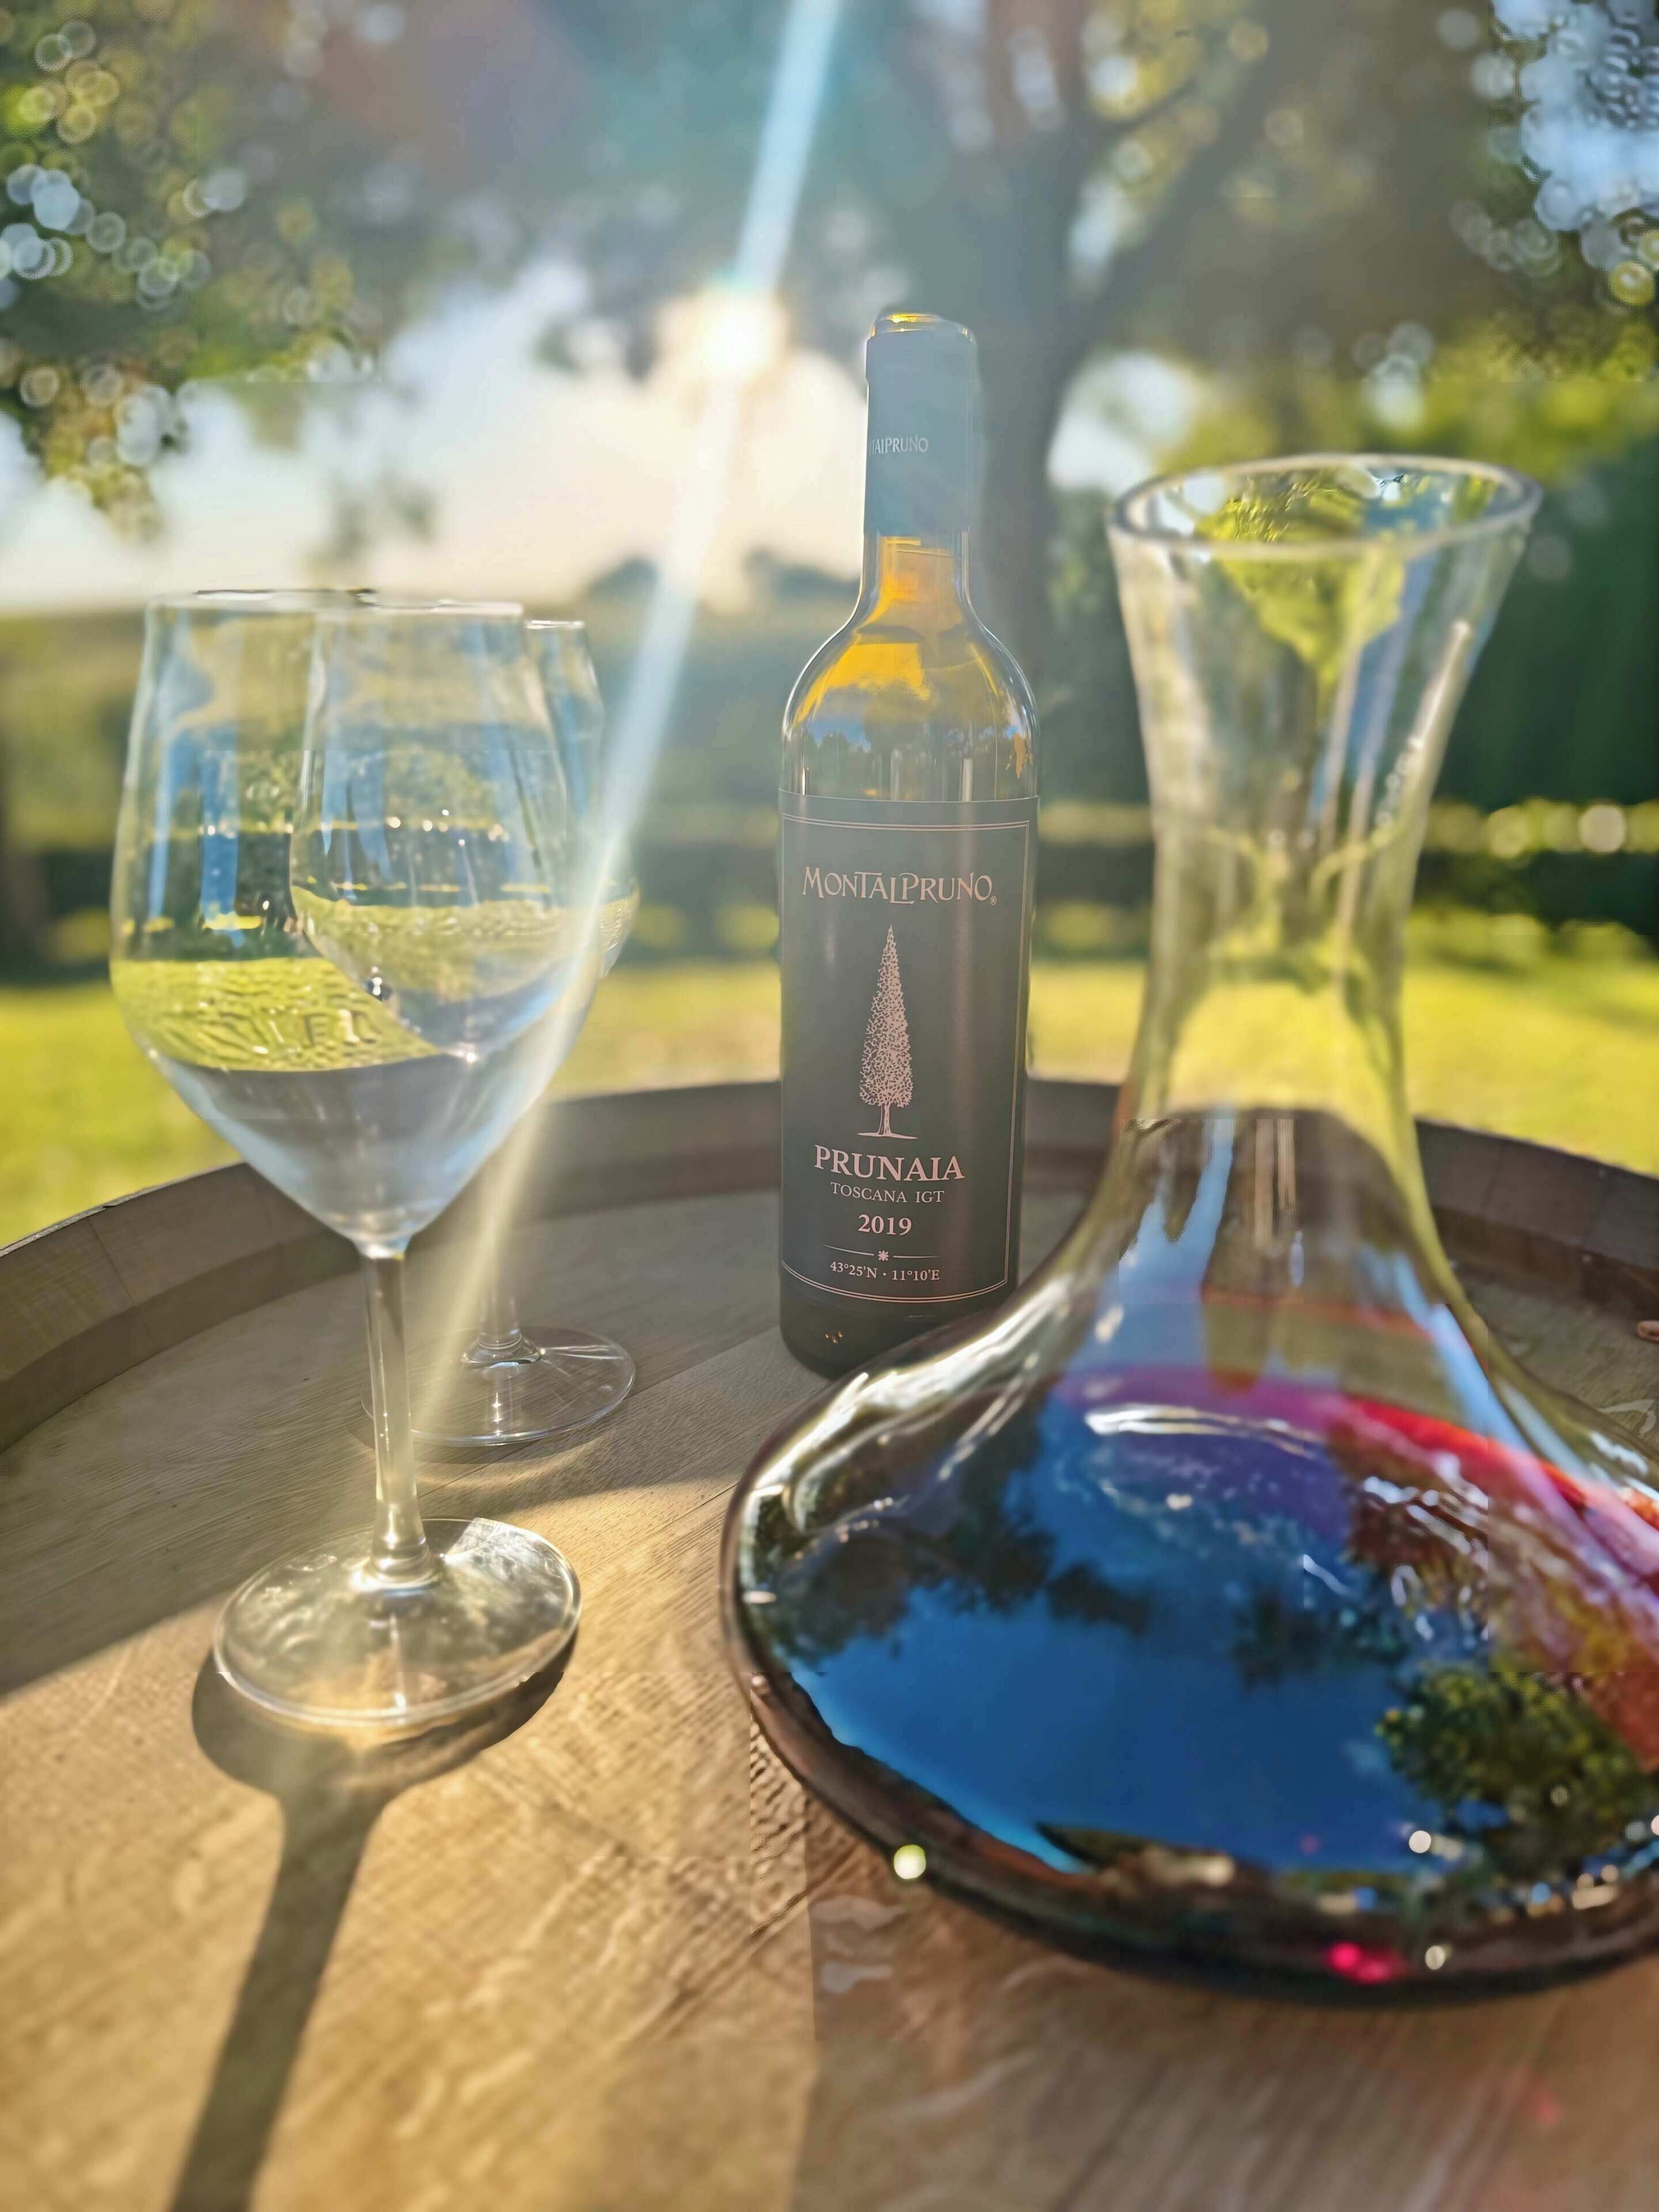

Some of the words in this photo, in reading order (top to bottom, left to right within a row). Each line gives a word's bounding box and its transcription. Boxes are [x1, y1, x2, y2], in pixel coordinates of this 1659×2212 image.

[814, 1144, 965, 1181] PRUNAIA
[830, 1182, 907, 1203] TOSCANA
[915, 1191, 945, 1203] IGT
[858, 1214, 912, 1235] 2019
